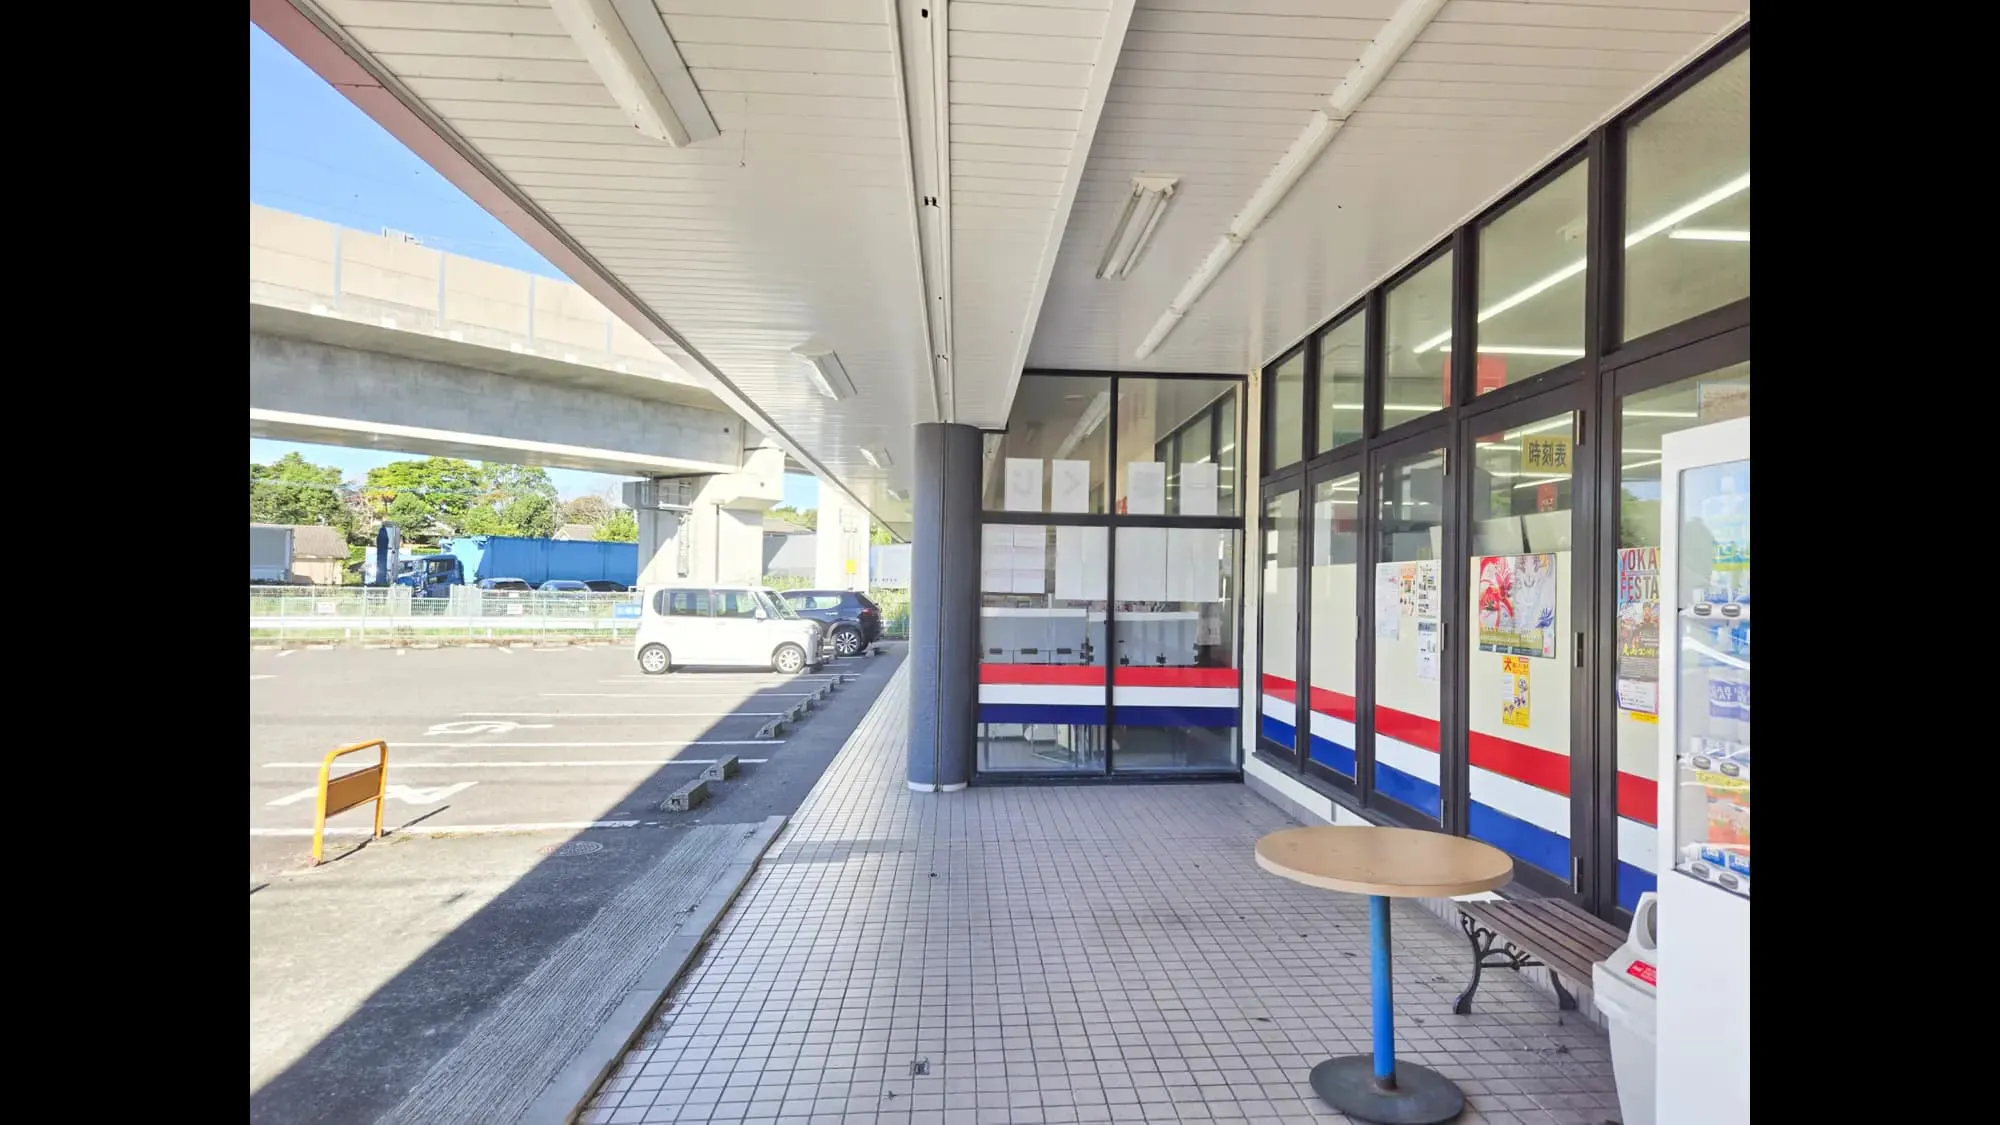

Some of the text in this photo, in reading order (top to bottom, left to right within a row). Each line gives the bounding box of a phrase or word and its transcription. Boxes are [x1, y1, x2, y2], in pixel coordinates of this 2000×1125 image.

[1528, 440, 1567, 468] 時刻表
[1620, 575, 1660, 600] FESTA
